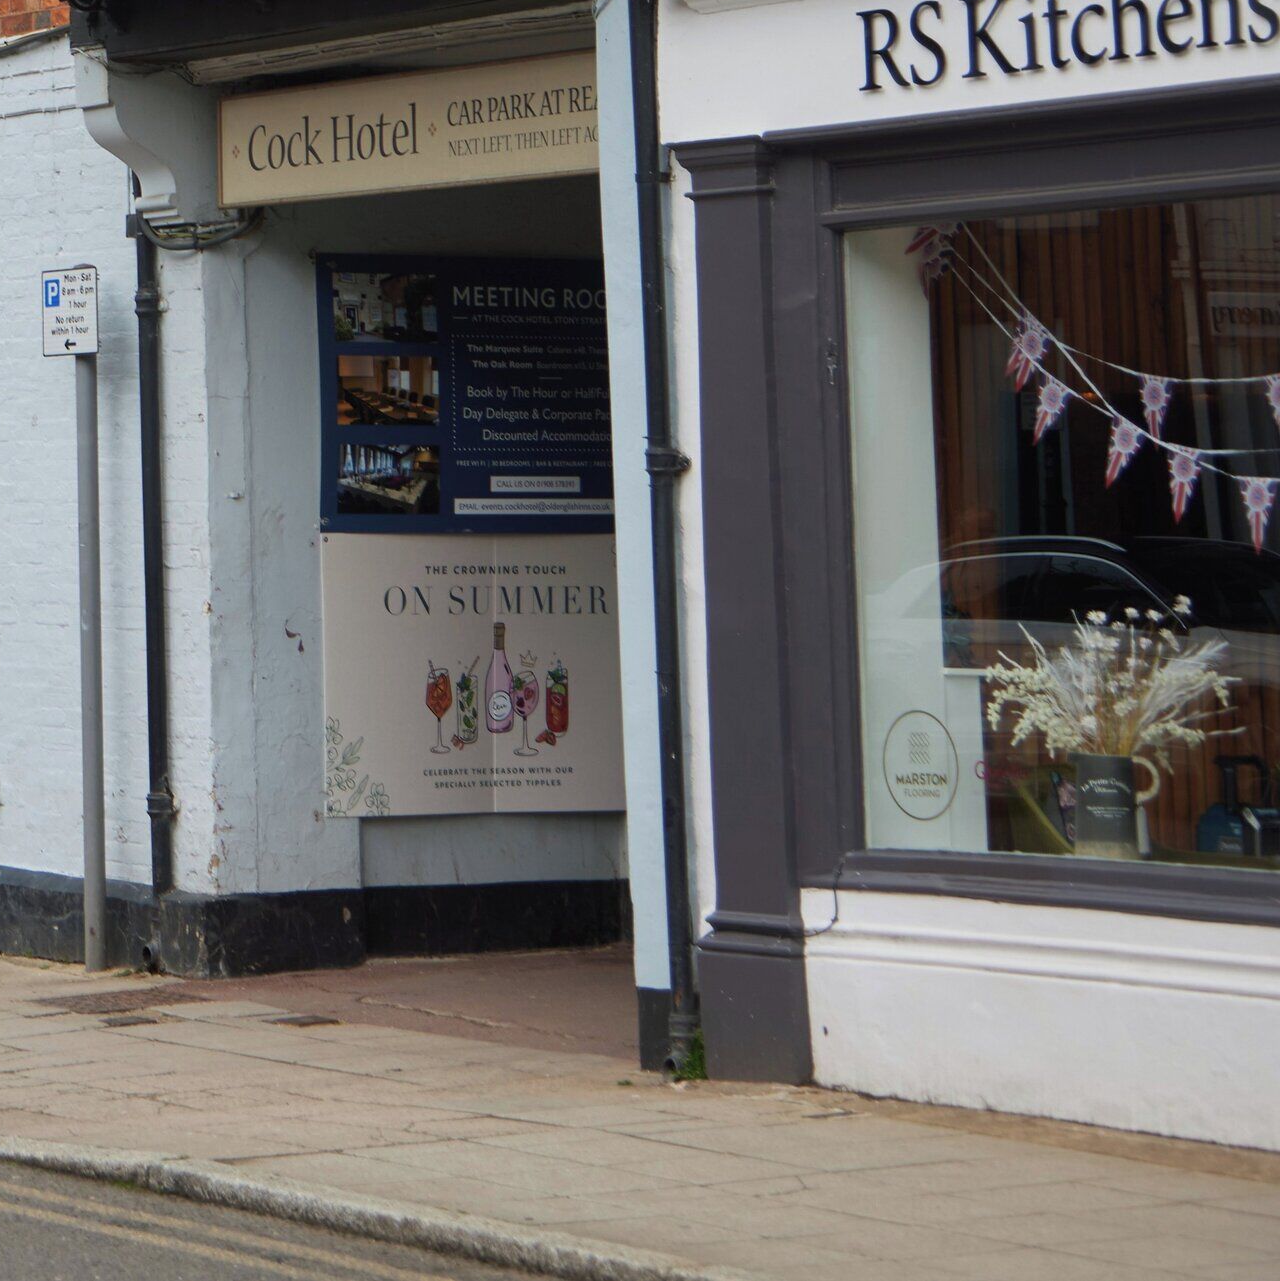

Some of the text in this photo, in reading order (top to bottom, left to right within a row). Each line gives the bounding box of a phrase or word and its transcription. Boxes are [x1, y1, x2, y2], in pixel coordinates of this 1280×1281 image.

[855, 0, 948, 91] RS
[247, 85, 597, 172] Cock Hotel CAR PARK AT RE
[448, 138, 481, 157] NEXT
[515, 130, 549, 150] THEN
[551, 126, 582, 146] LEFT
[64, 274, 77, 283] Mon
[81, 272, 91, 282] Sat
[452, 286, 556, 308] MEETING
[56, 315, 85, 324] No return
[51, 327, 70, 336] within
[467, 344, 483, 353] The
[485, 344, 521, 355] Marquee
[523, 345, 544, 353] Suite
[472, 360, 489, 368] The
[490, 360, 507, 368] Oak
[509, 360, 533, 369] Room
[467, 385, 494, 398] Book
[496, 386, 509, 401] by
[510, 386, 530, 399] The
[532, 386, 558, 399] Hour
[561, 390, 571, 399] or
[463, 407, 484, 422] Day
[486, 407, 530, 423] Delegate
[532, 408, 540, 420] &
[542, 408, 593, 423] Corporate
[482, 429, 539, 441] Discounted
[496, 480, 514, 488] CALL
[424, 565, 567, 575] THE CROWNING TOUCH
[383, 584, 610, 616] ON SUMMER
[423, 768, 469, 777] CELEBRATE
[489, 767, 526, 775] SEASON
[555, 766, 574, 774] OUR
[434, 779, 562, 789] SPECIALLY SELECTED TIPPLES
[896, 772, 948, 786] MARSTON
[904, 788, 941, 798] FLOORING
